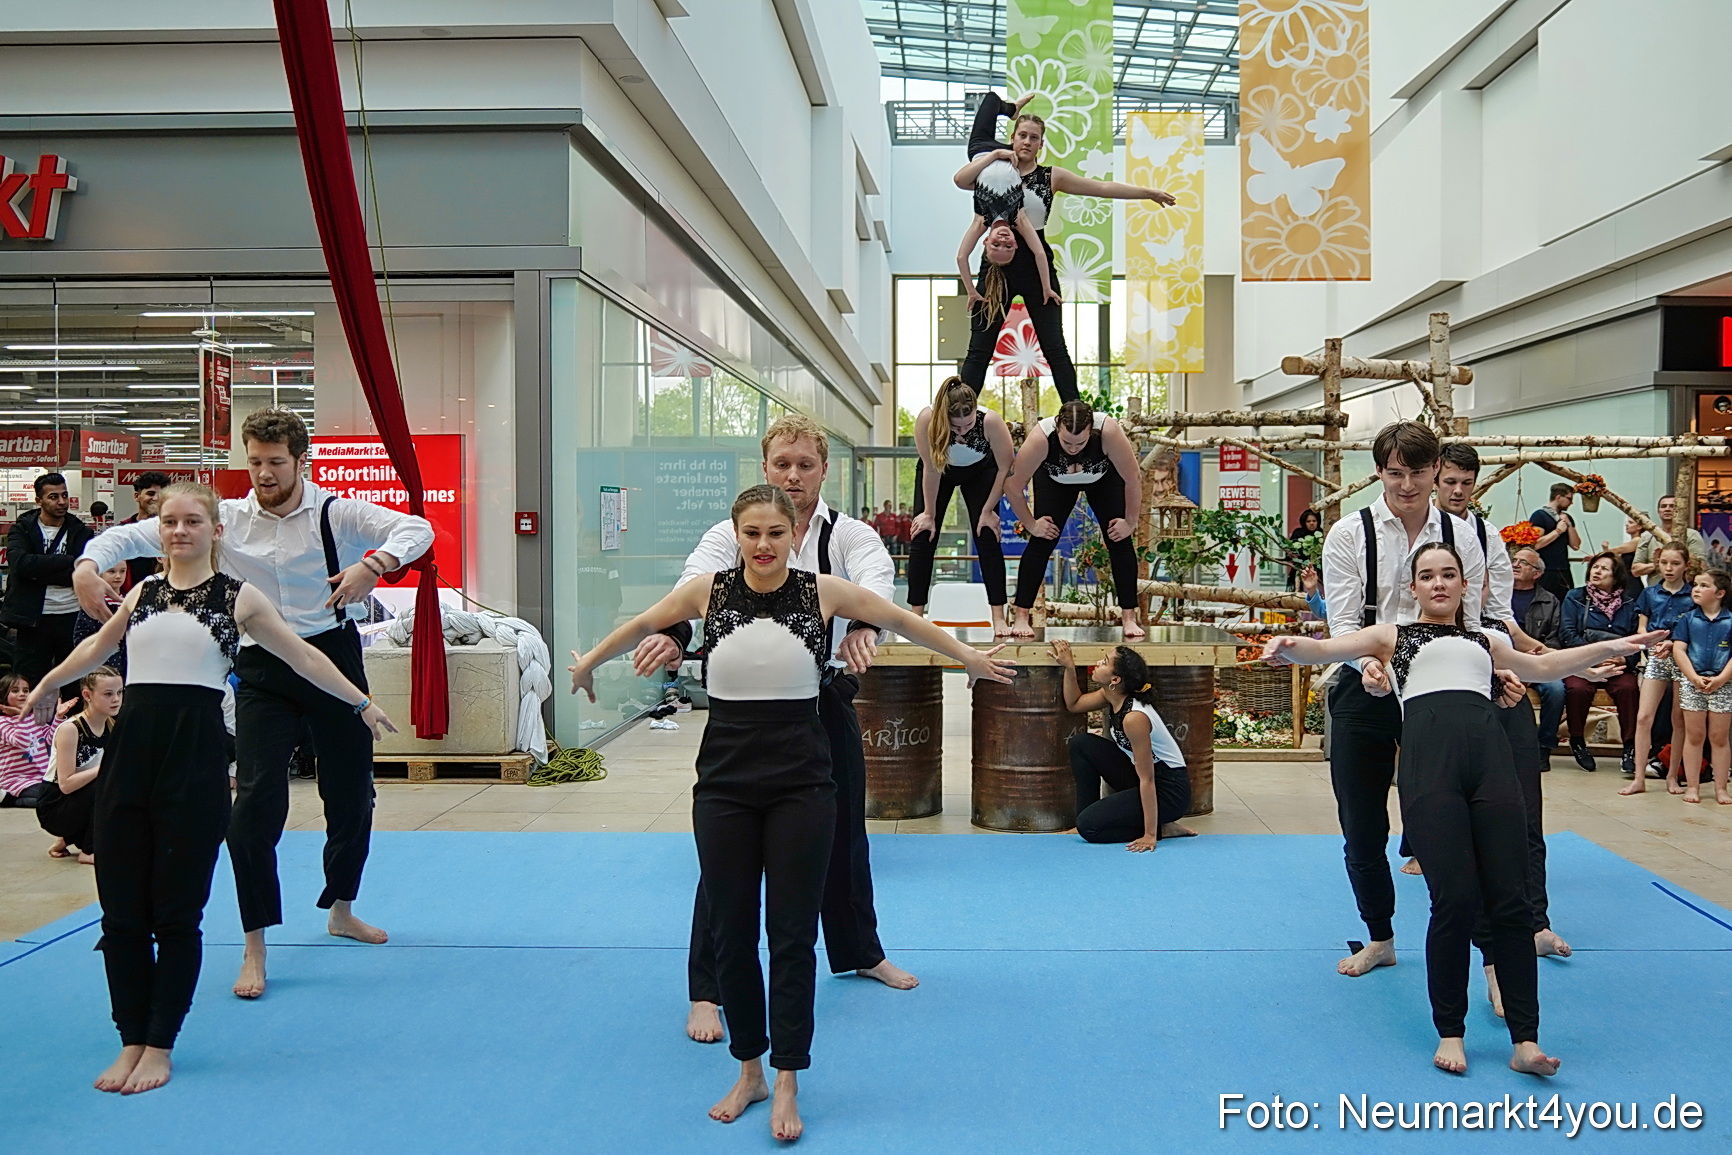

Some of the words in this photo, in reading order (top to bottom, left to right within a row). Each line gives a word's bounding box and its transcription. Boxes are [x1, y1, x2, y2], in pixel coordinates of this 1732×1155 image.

[88, 437, 129, 455] Smartbar
[318, 447, 374, 456] MediaMarkt
[318, 465, 402, 482] Soforthilf
[1220, 487, 1246, 499] REWE
